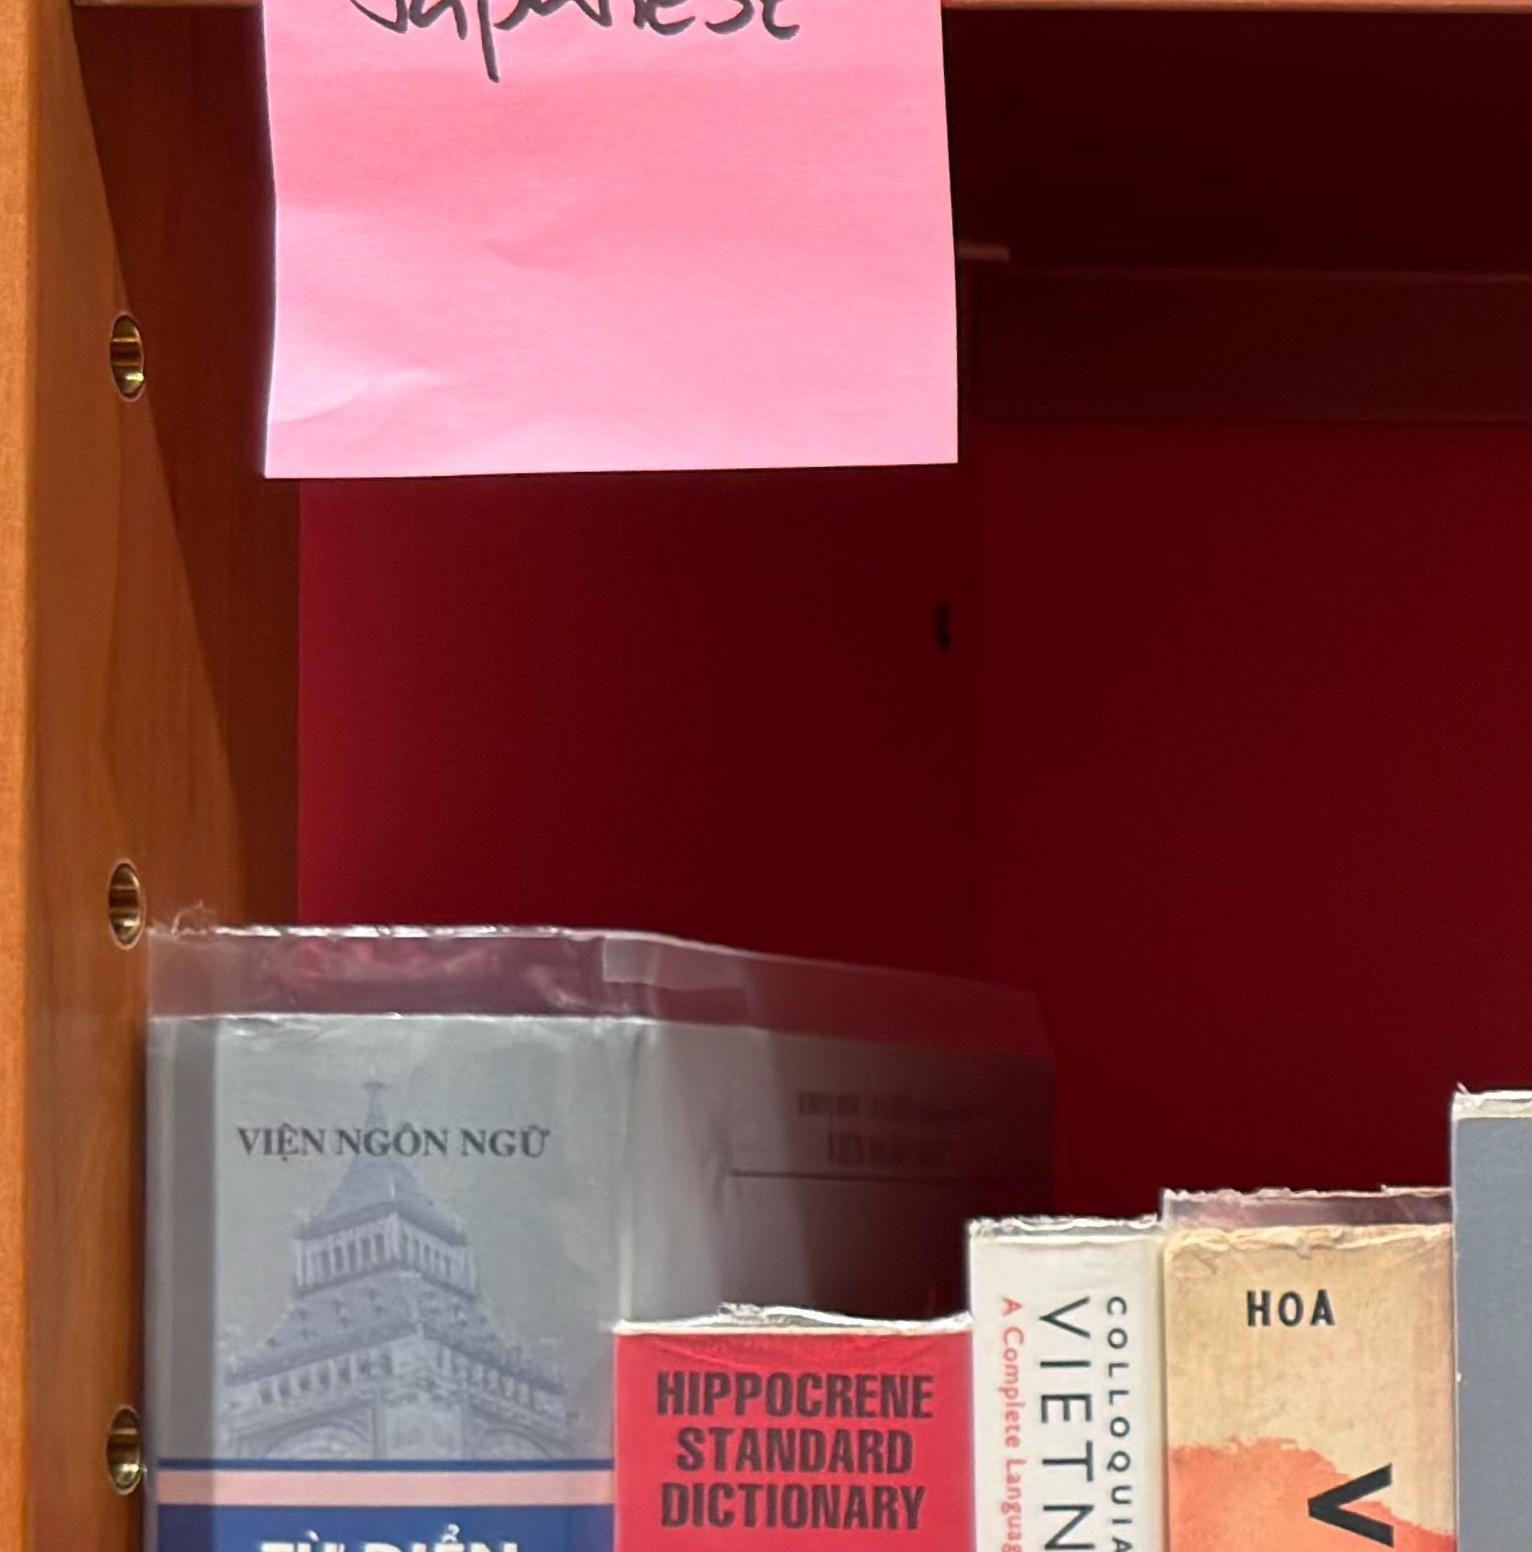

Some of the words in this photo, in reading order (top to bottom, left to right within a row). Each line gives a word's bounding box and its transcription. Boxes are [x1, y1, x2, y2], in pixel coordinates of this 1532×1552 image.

[237, 1122, 325, 1162] VIỆN
[335, 1122, 449, 1158] NGÔN
[1001, 1295, 1023, 1317] A
[1245, 1289, 1336, 1327] HOA
[655, 1369, 936, 1421] HIPPOCRENE
[997, 1327, 1026, 1449] Complete
[674, 1427, 915, 1475] STANDARD
[659, 1484, 927, 1531] DICTIONARY
